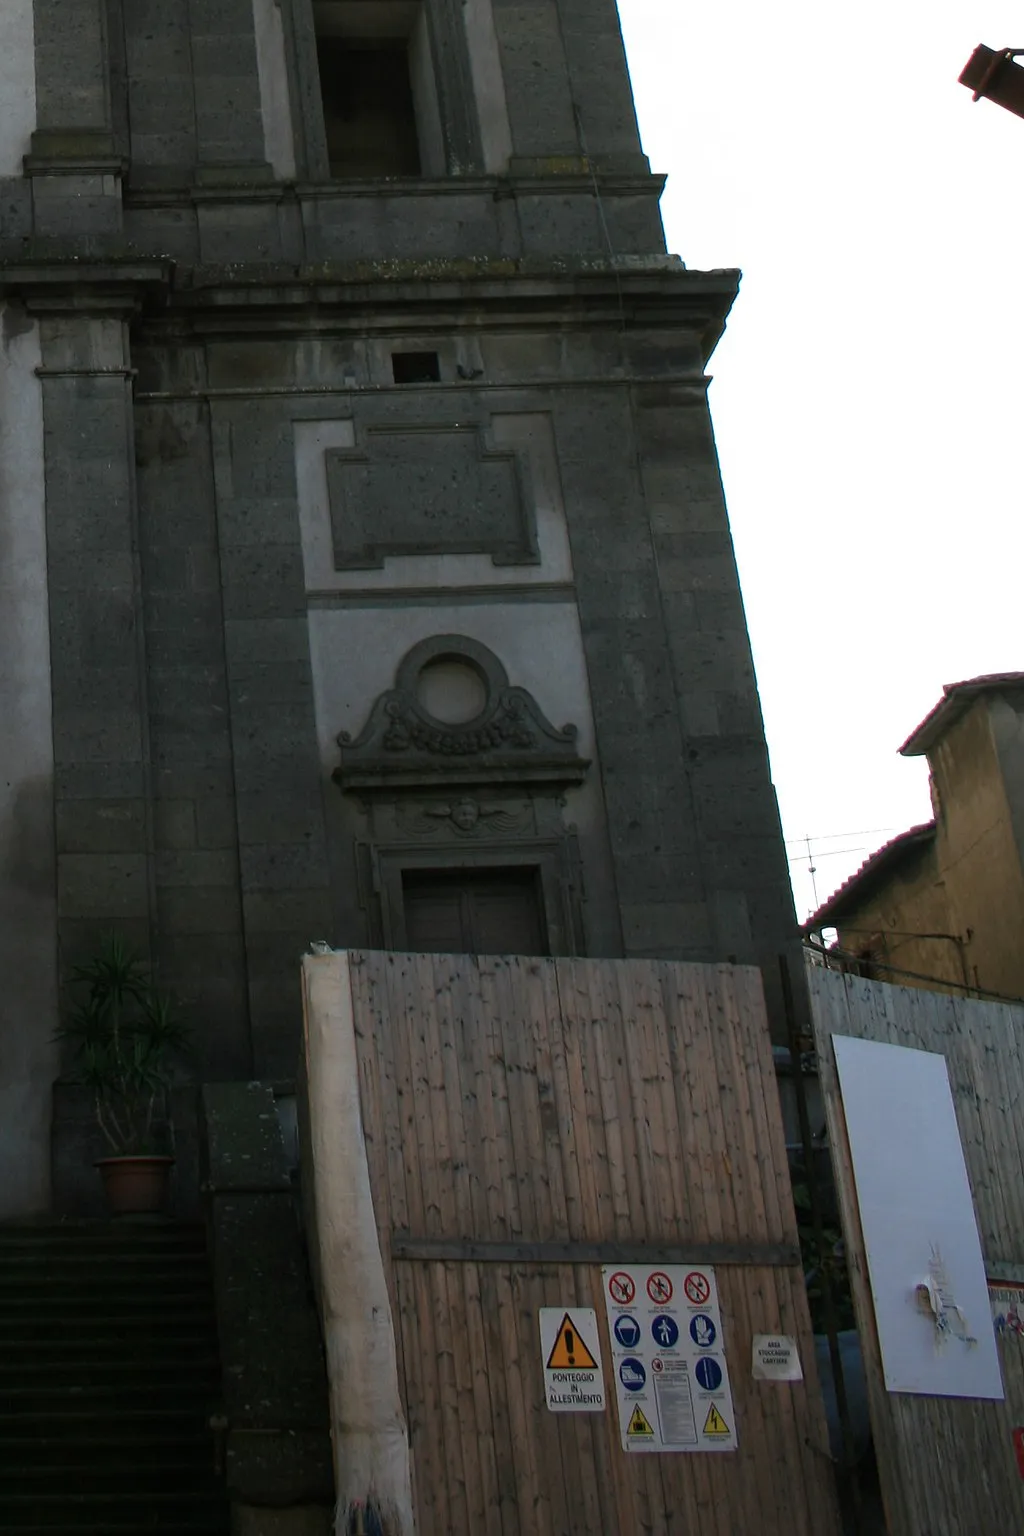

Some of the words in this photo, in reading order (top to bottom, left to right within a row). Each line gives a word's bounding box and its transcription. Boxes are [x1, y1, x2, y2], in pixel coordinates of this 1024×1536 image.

[552, 1372, 595, 1382] PONTEGGIO
[570, 1383, 579, 1393] IN
[549, 1393, 603, 1404] ALLESTIMENTO
